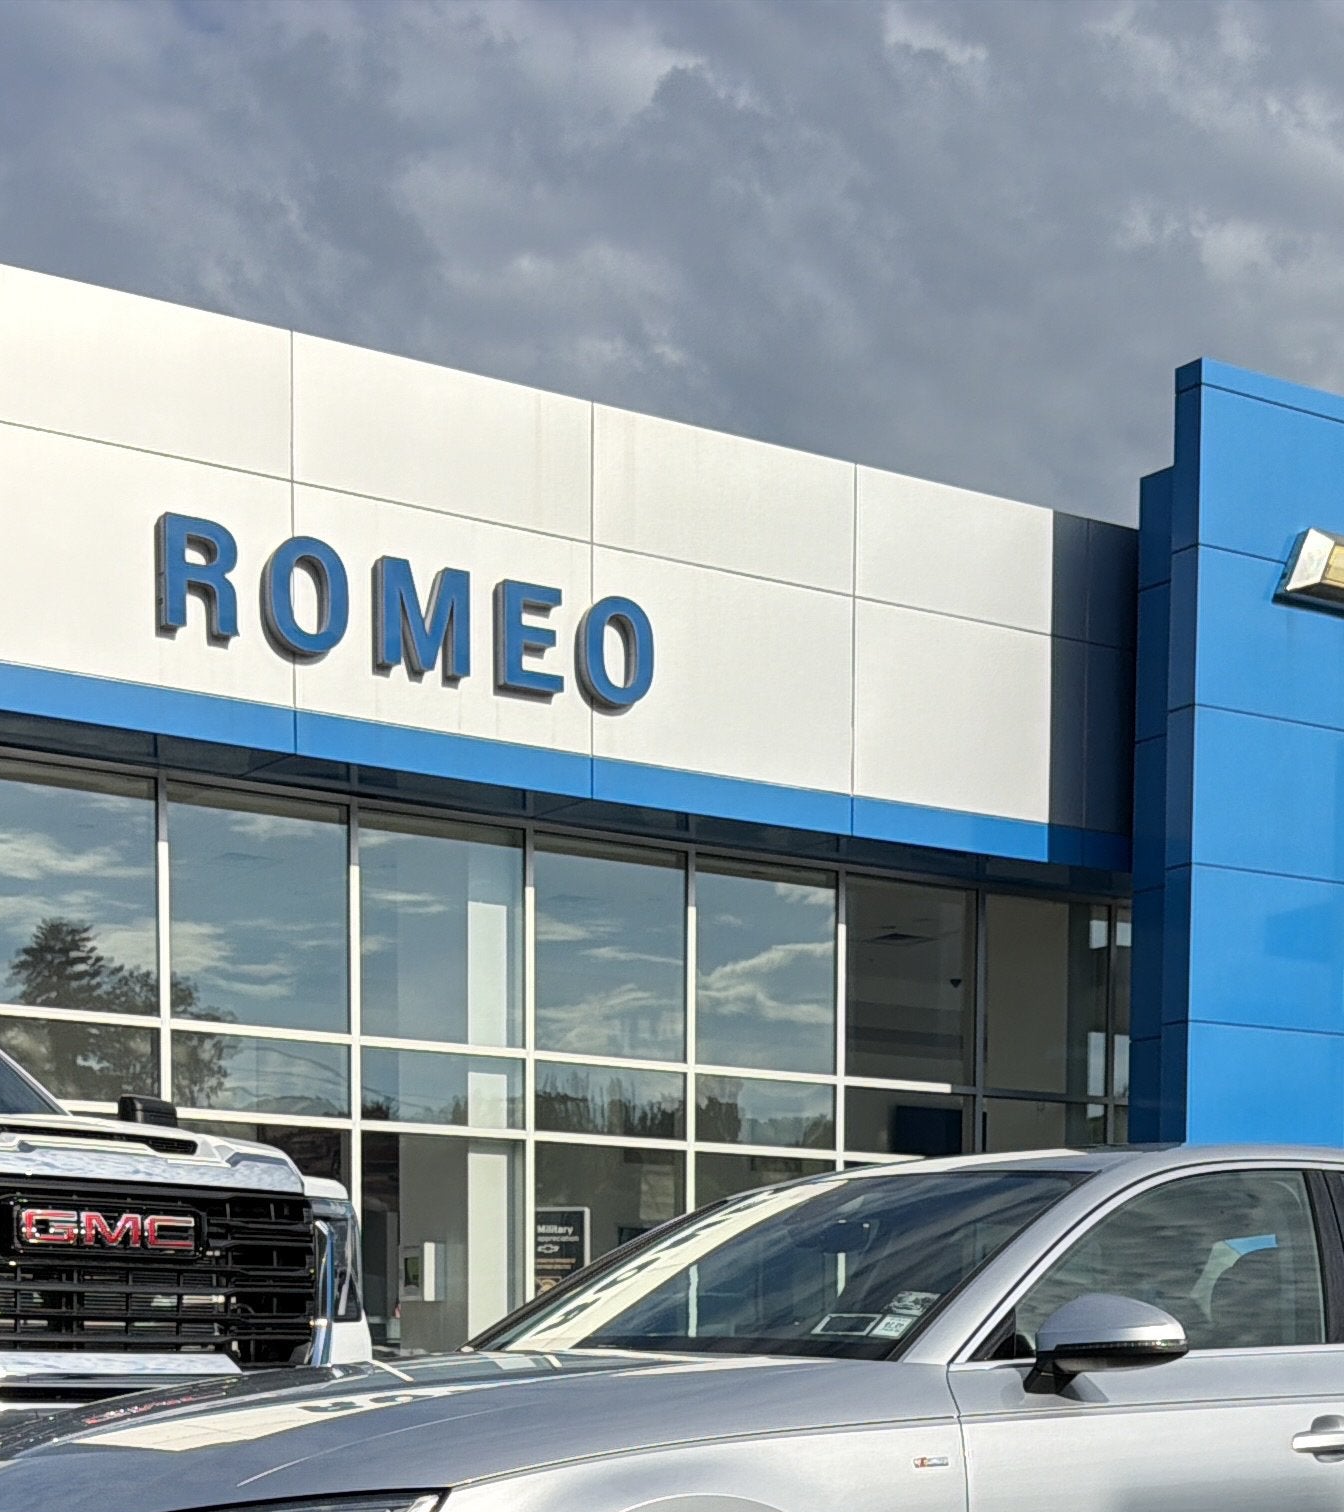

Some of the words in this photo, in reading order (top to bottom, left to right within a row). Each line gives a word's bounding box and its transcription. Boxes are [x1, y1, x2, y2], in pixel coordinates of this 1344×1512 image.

[155, 512, 655, 706] ROMEO
[22, 1208, 196, 1250] GMC
[537, 1224, 574, 1236] Military
